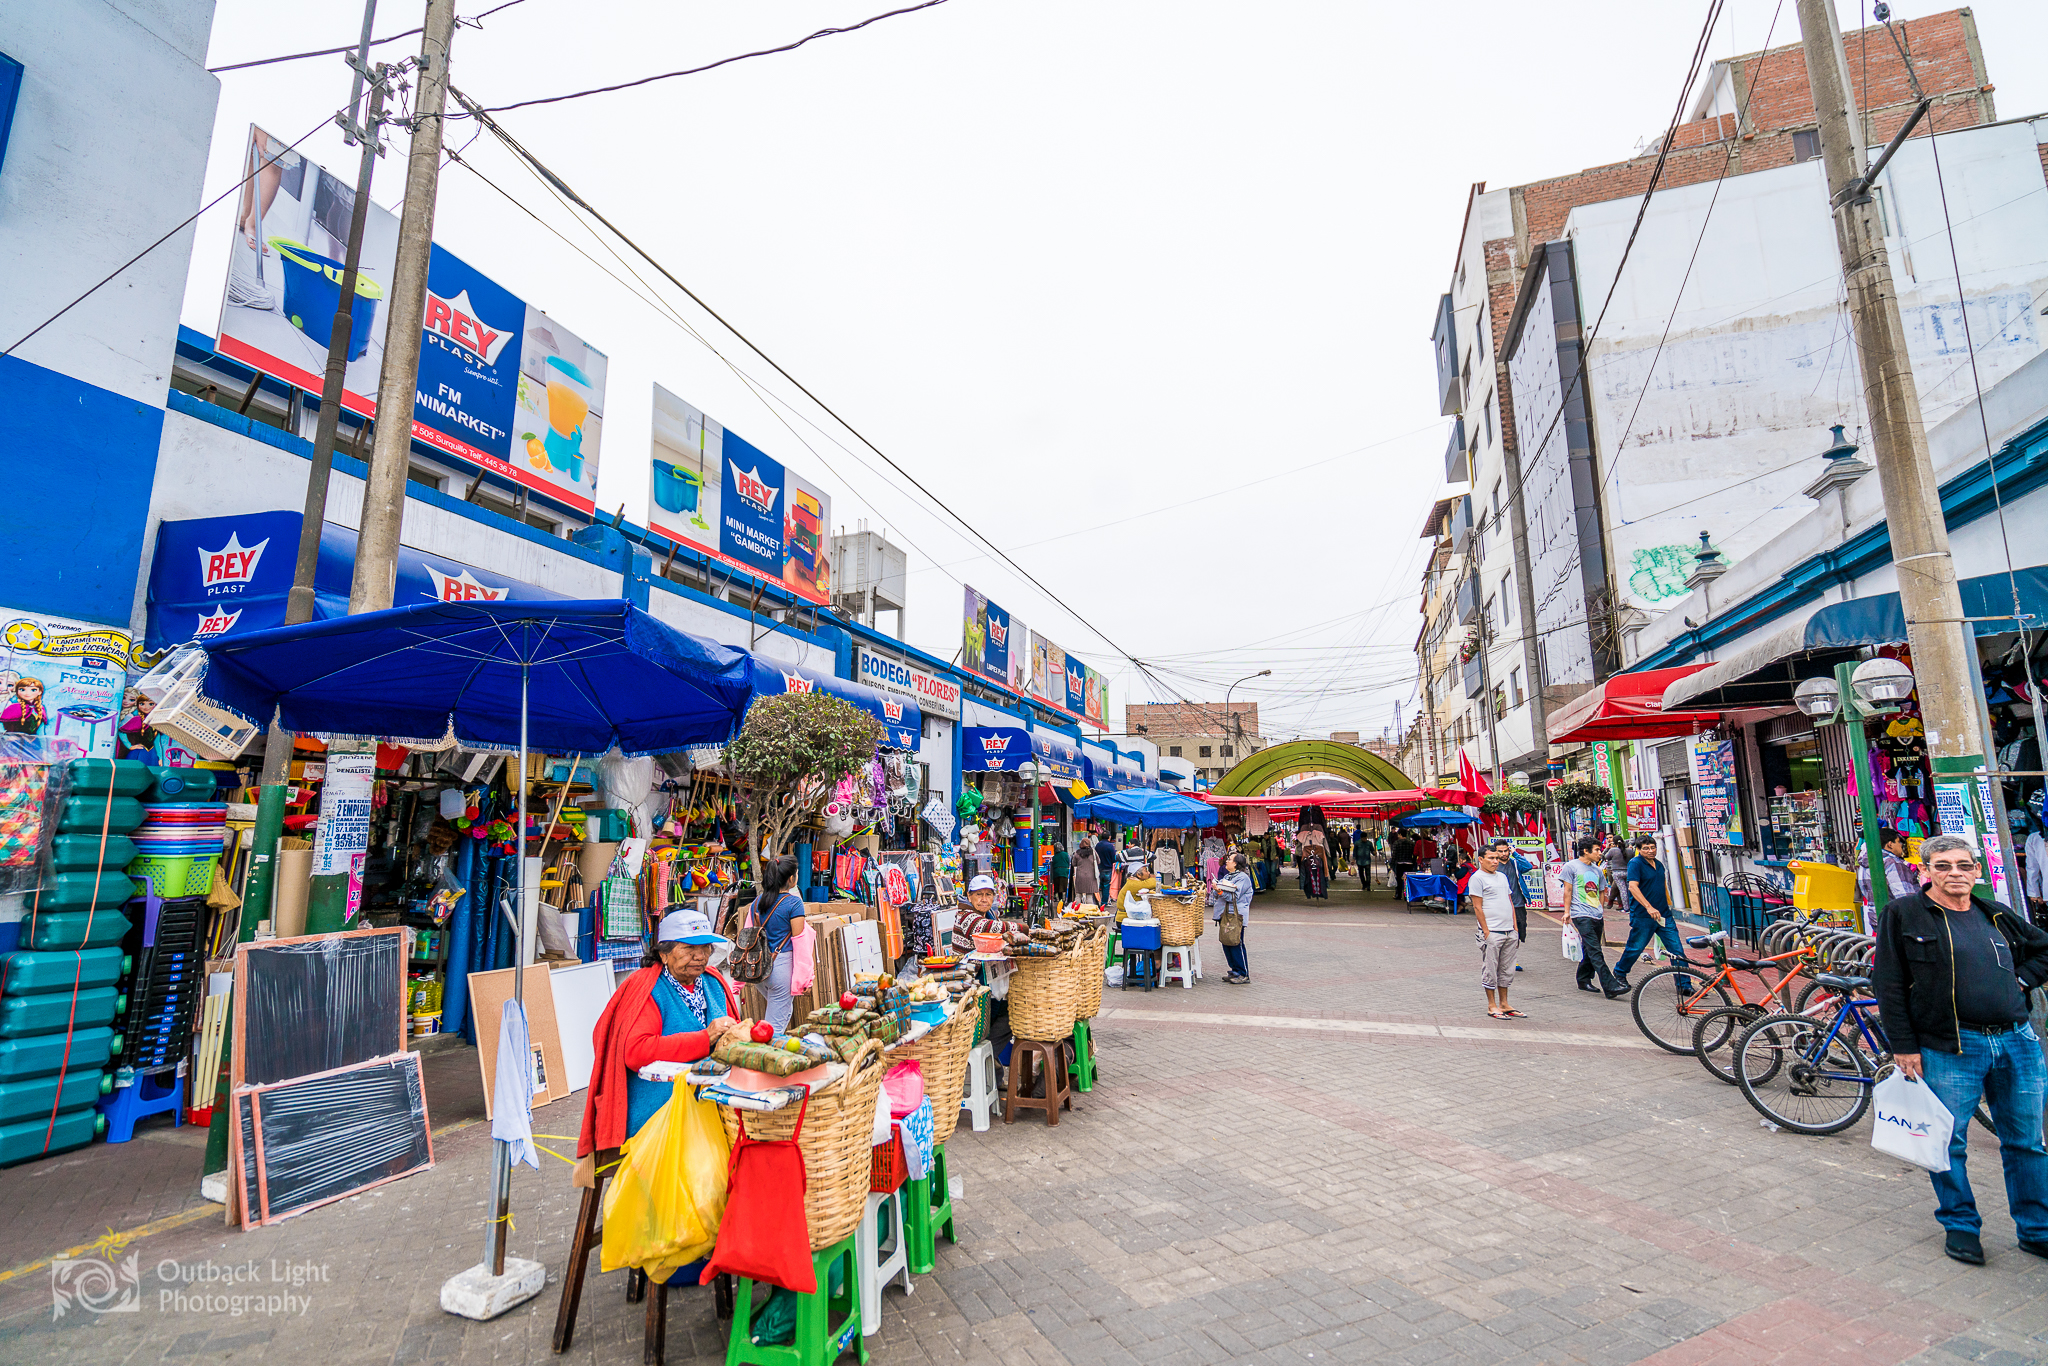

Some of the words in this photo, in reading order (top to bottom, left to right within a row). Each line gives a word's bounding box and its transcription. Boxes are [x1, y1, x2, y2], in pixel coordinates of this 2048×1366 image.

[425, 294, 498, 359] REY
[428, 334, 485, 370] PLAST
[438, 383, 462, 405] FM
[419, 427, 434, 440] 505
[436, 434, 468, 455] Surquillo
[484, 457, 498, 468] 445
[498, 463, 508, 472] 36
[508, 467, 517, 477] 78
[739, 472, 773, 508] REY
[741, 497, 768, 515] PLAST
[726, 515, 745, 533] MINI
[746, 525, 780, 550] MARKET
[207, 549, 257, 583] REY
[208, 585, 246, 597] PLAST
[47, 622, 82, 633] PRÓXIMOS
[198, 615, 235, 634] REY
[991, 622, 1006, 643] REY
[82, 642, 128, 660] LICENCIAS!
[991, 639, 1003, 649] PLAST
[59, 671, 116, 689] FROZEN
[788, 677, 811, 695] REY
[861, 652, 912, 689] BODEGA
[911, 673, 960, 703] “FLORES”
[1069, 674, 1081, 695] REY
[885, 702, 901, 719] REY
[918, 696, 945, 713] CONSERVAS
[901, 735, 911, 745] REY
[985, 739, 1007, 749] REY
[1594, 743, 1615, 816] CORTIS
[336, 803, 342, 817] 2
[1878, 1110, 1912, 1130] LAN
